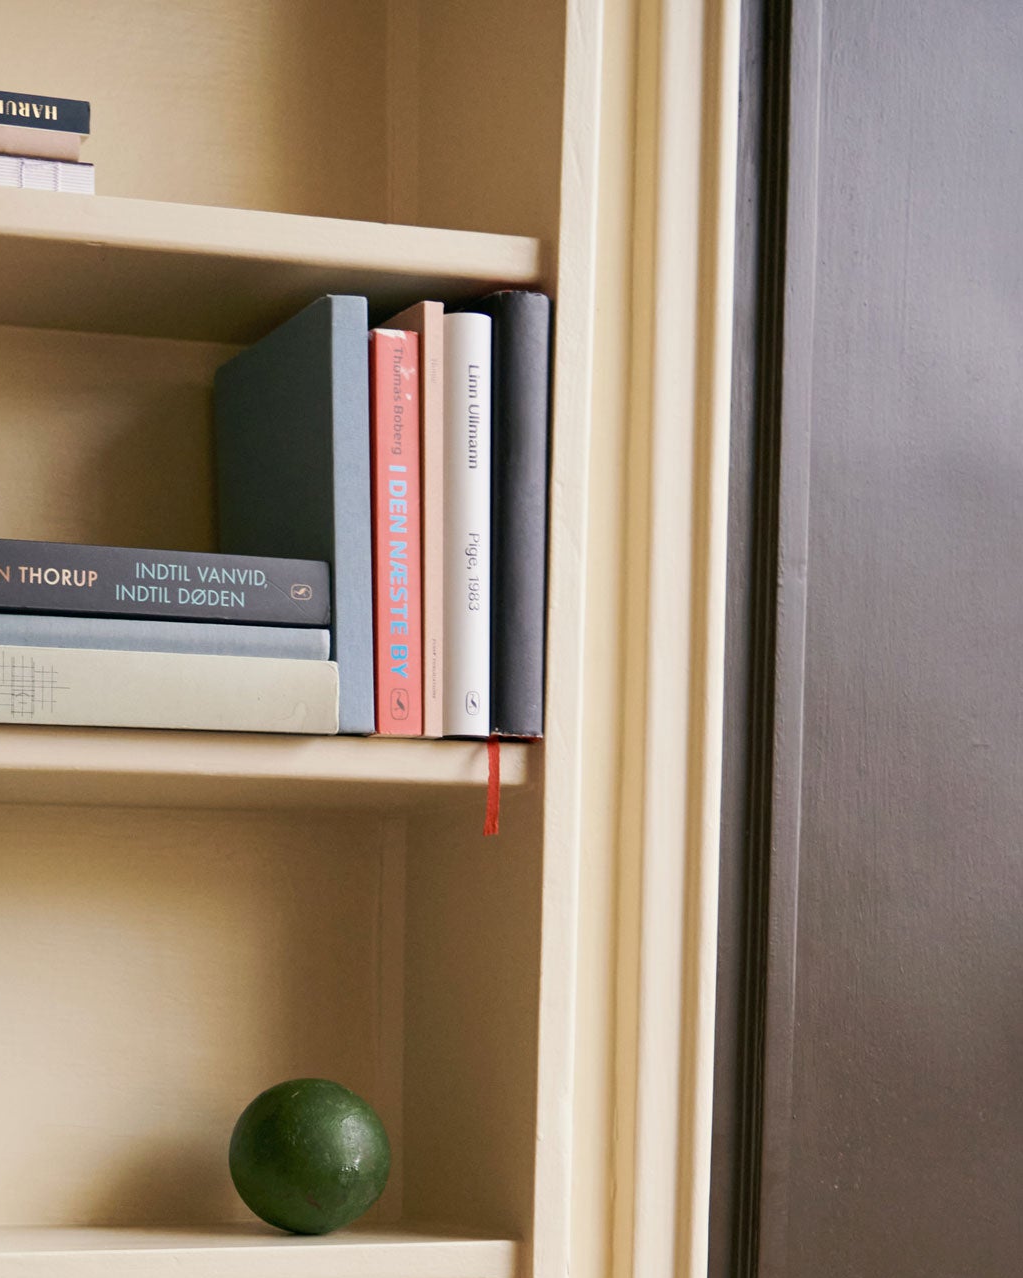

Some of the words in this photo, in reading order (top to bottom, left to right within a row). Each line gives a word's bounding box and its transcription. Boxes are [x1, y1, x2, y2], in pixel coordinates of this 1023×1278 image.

[391, 346, 405, 402] Thomas
[467, 363, 480, 400] Linn
[390, 404, 405, 456] Boberg
[467, 403, 480, 470] Ullmann
[388, 464, 407, 474] I
[388, 479, 408, 534] DEN
[464, 532, 480, 571] Pige,
[17, 565, 99, 588] THORUP
[135, 561, 191, 585] INDTIL
[197, 565, 269, 590] VANVID,
[389, 538, 409, 636] NÆSTE
[467, 576, 480, 612] 1983
[114, 583, 172, 605] INDTIL
[177, 585, 246, 608] DØDEN
[390, 642, 409, 680] BY
